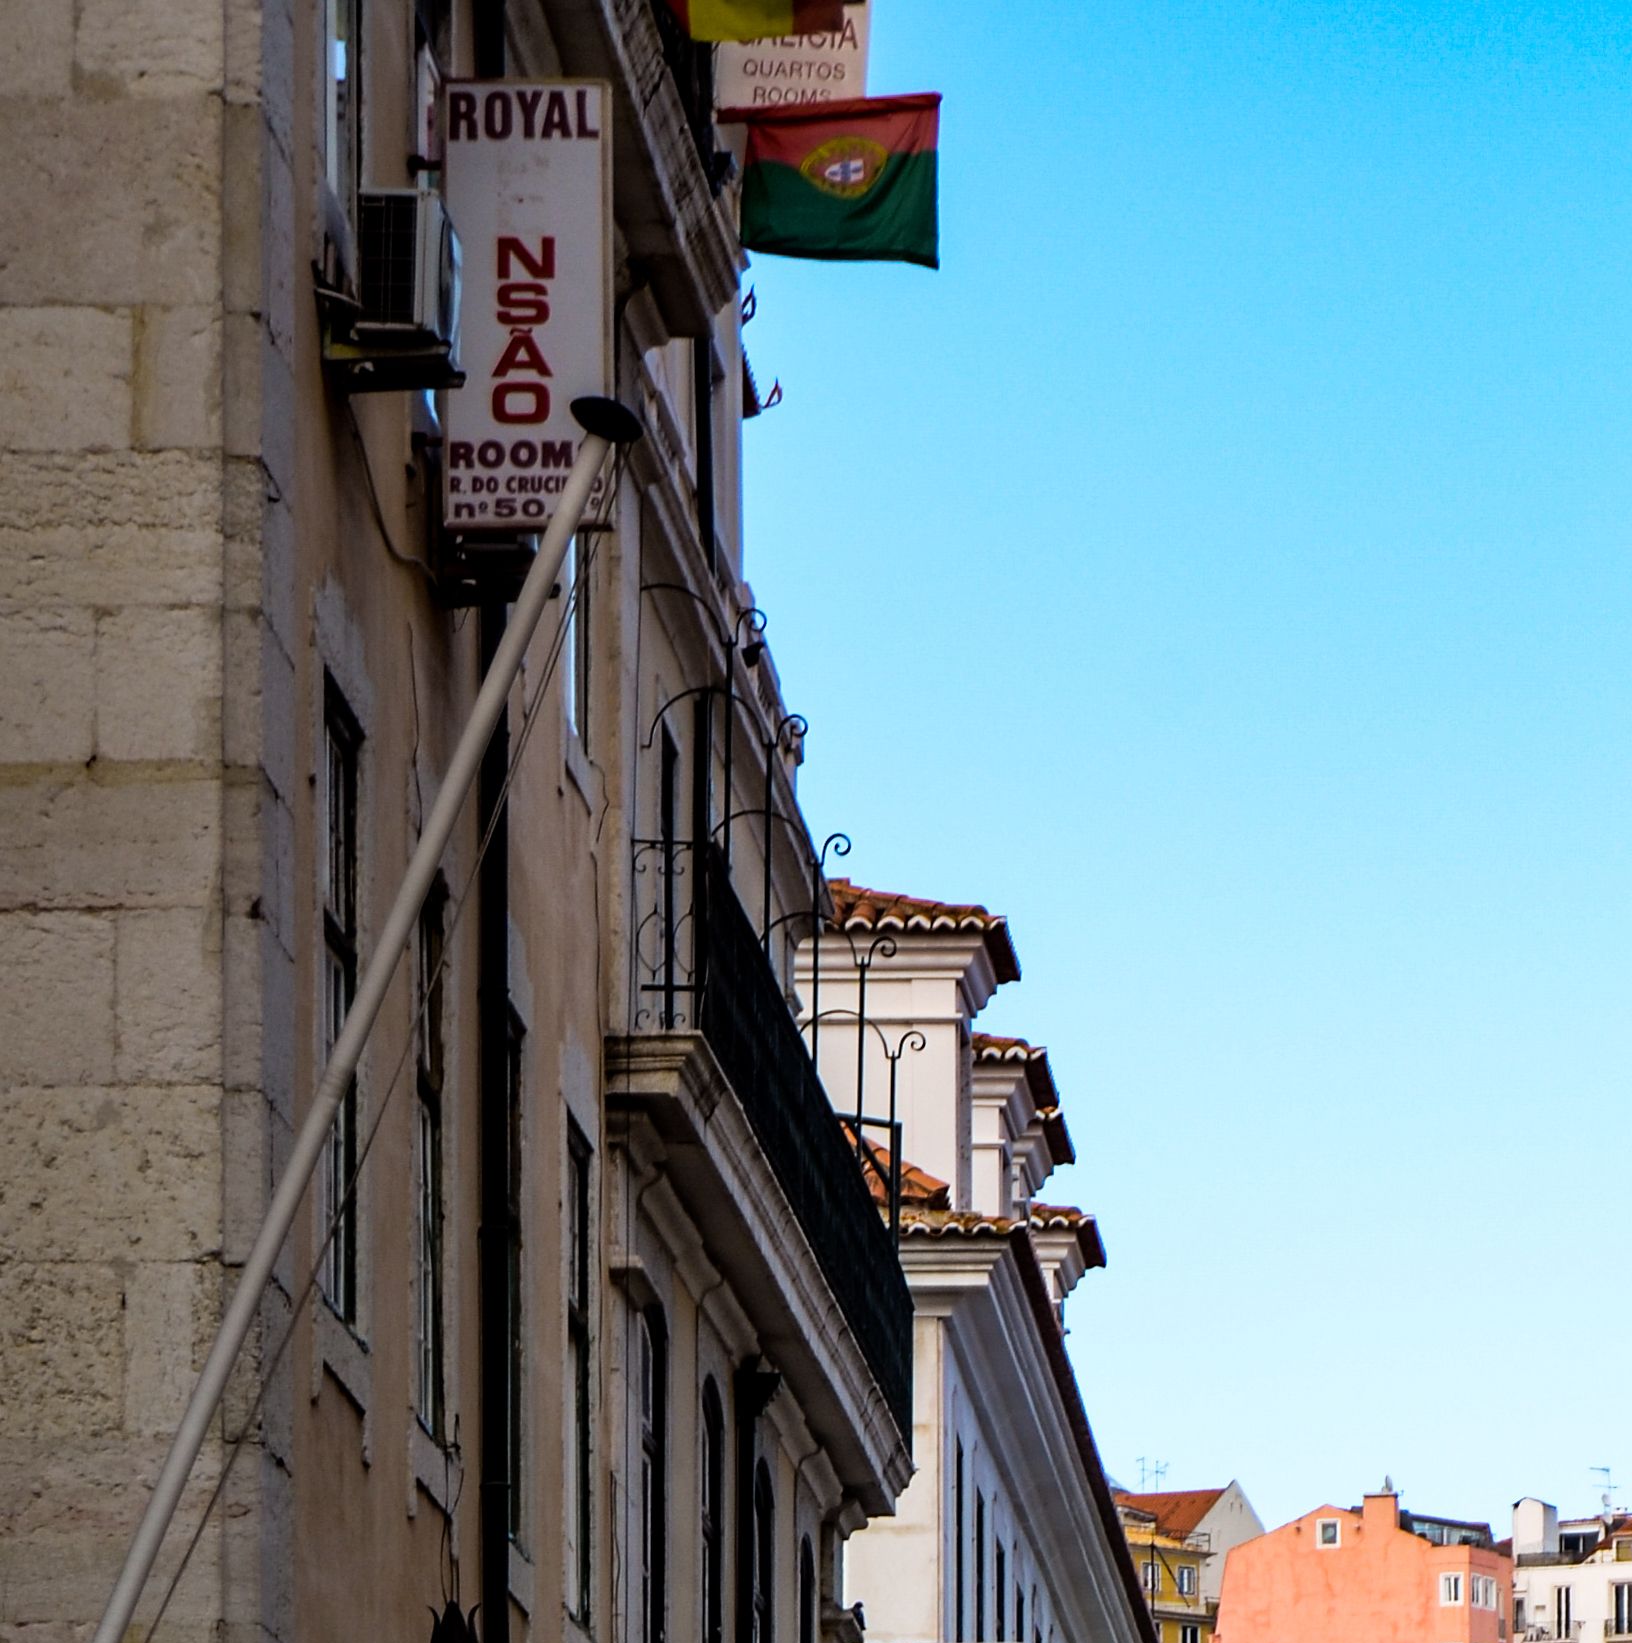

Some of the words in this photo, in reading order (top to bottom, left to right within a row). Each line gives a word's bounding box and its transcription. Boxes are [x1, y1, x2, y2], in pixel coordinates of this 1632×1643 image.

[743, 59, 846, 81] QUARTOS
[449, 89, 600, 141] ROYAL
[450, 440, 585, 469] ROOM
[471, 476, 499, 493] DO
[506, 476, 603, 494] CRUCIO
